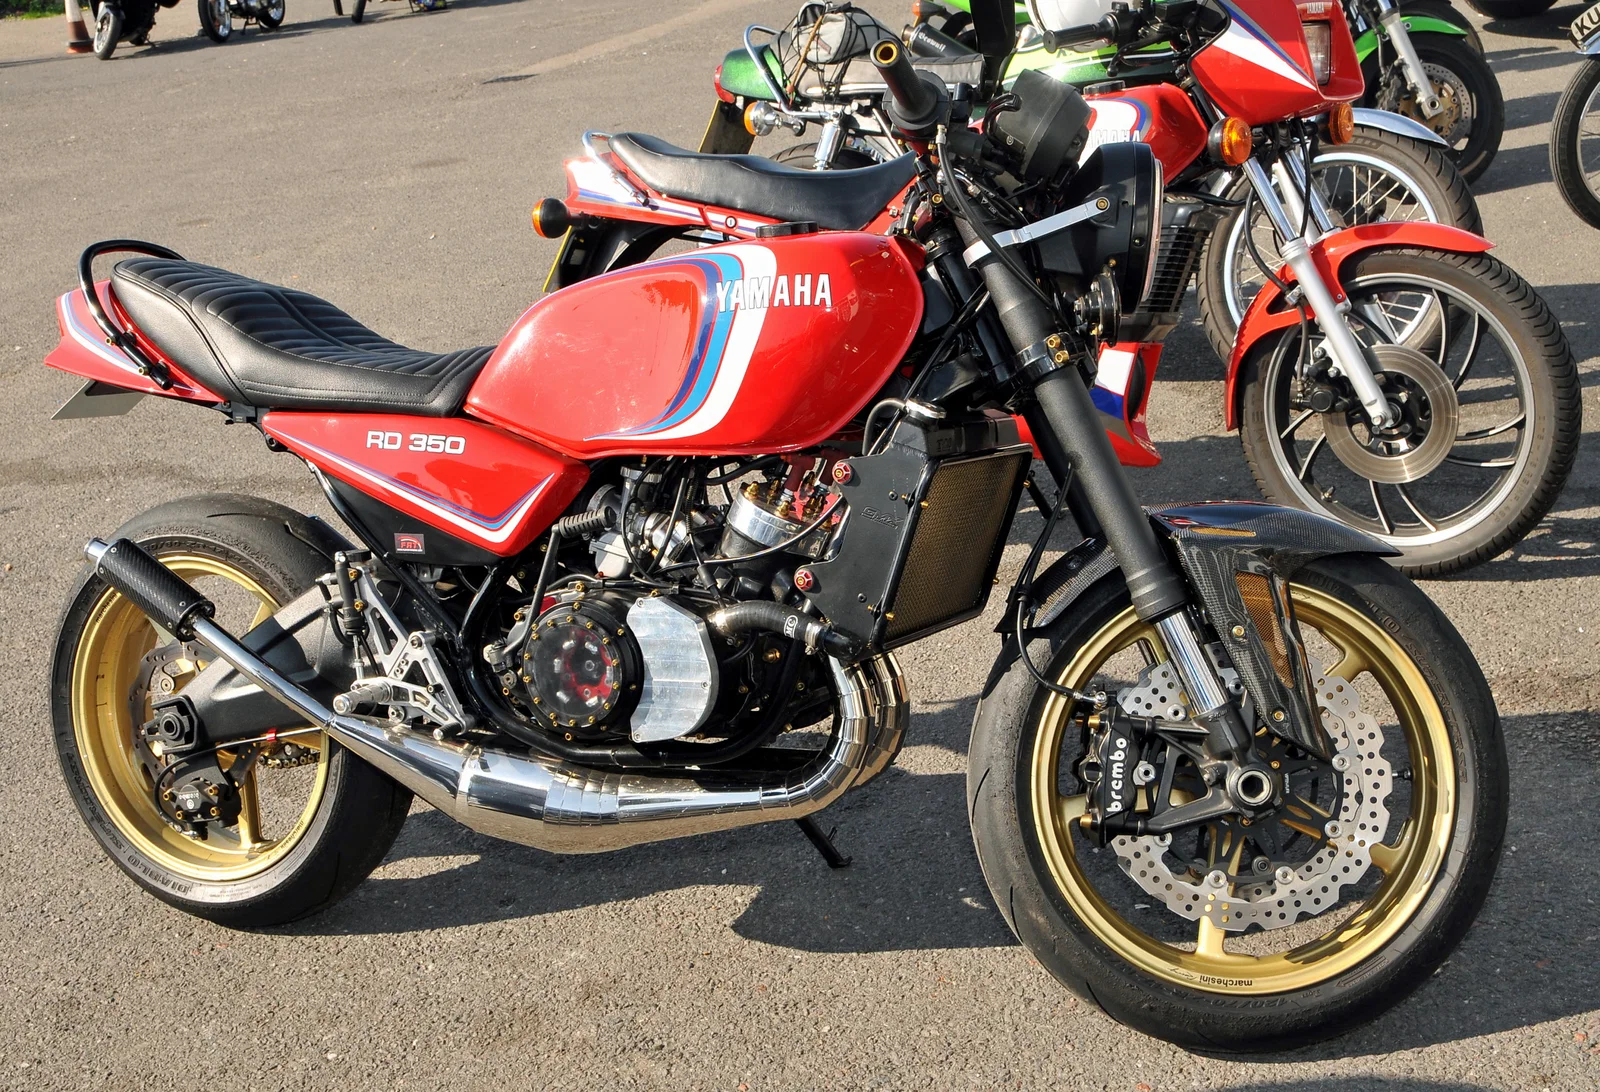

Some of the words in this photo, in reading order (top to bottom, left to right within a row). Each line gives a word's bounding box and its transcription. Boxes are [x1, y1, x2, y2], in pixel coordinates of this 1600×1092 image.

[1088, 129, 1141, 149] AMAHA
[716, 273, 832, 313] YAMAHA
[366, 430, 402, 450] RD
[408, 433, 466, 455] 350
[1106, 738, 1127, 812] brembo
[1199, 975, 1253, 987] marchesini
